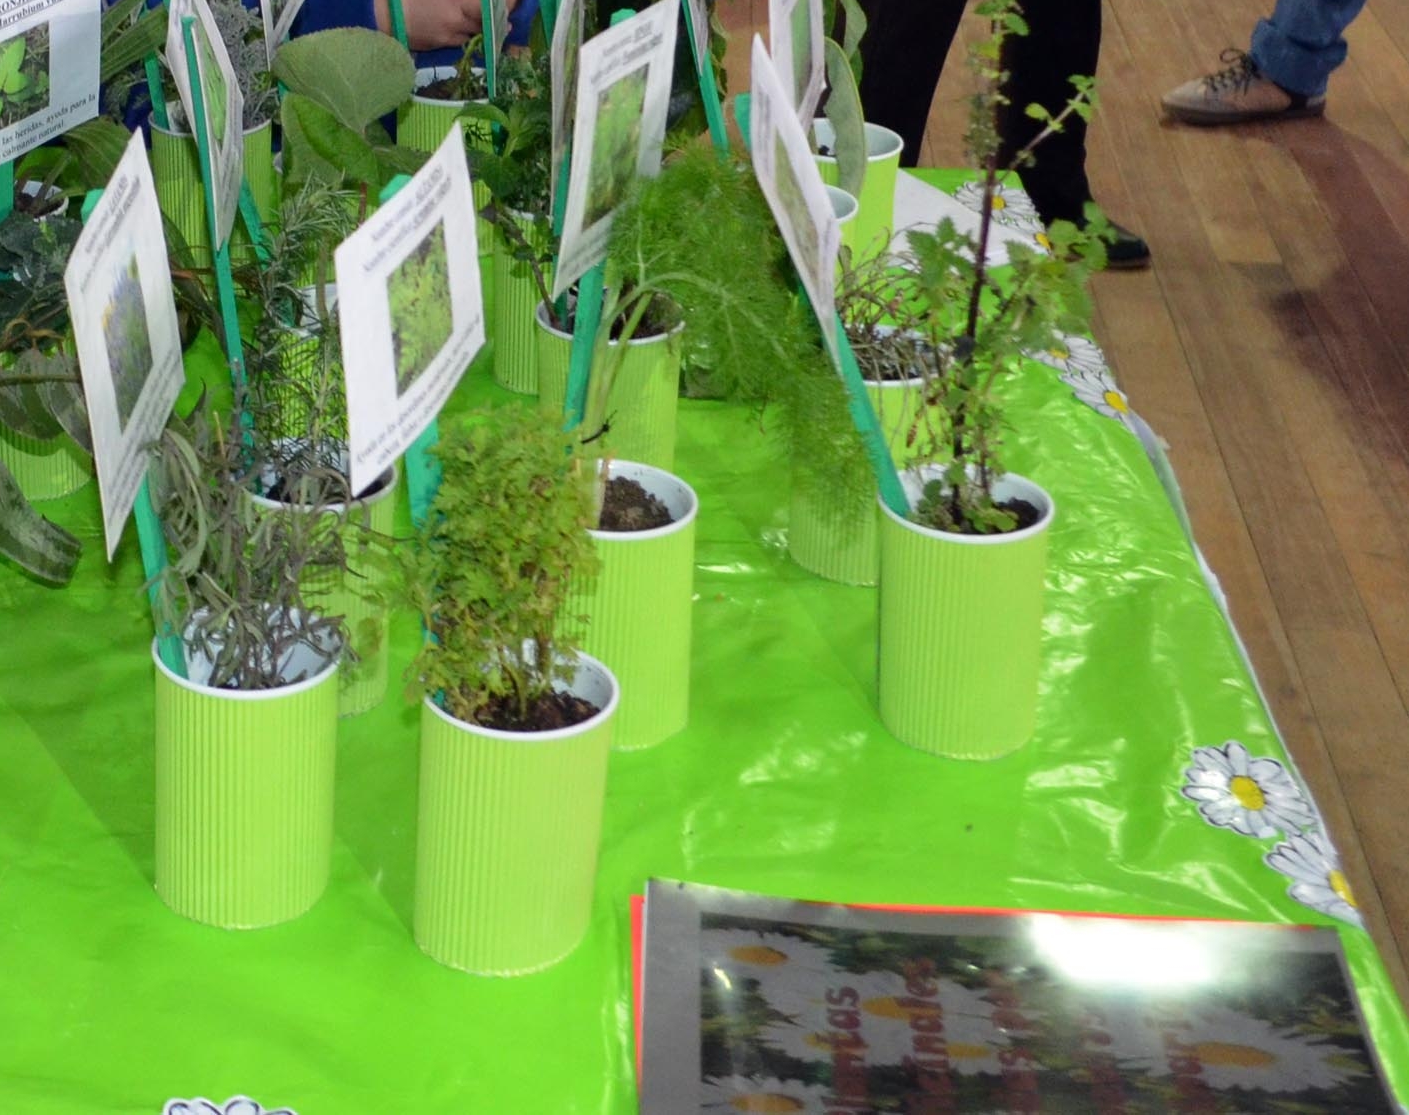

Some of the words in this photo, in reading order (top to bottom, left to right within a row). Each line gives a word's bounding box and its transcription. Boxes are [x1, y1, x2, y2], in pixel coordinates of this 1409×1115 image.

[2, 134, 13, 146] las
[46, 107, 69, 125] ayuda
[69, 97, 87, 114] para
[2, 137, 38, 159] calmante
